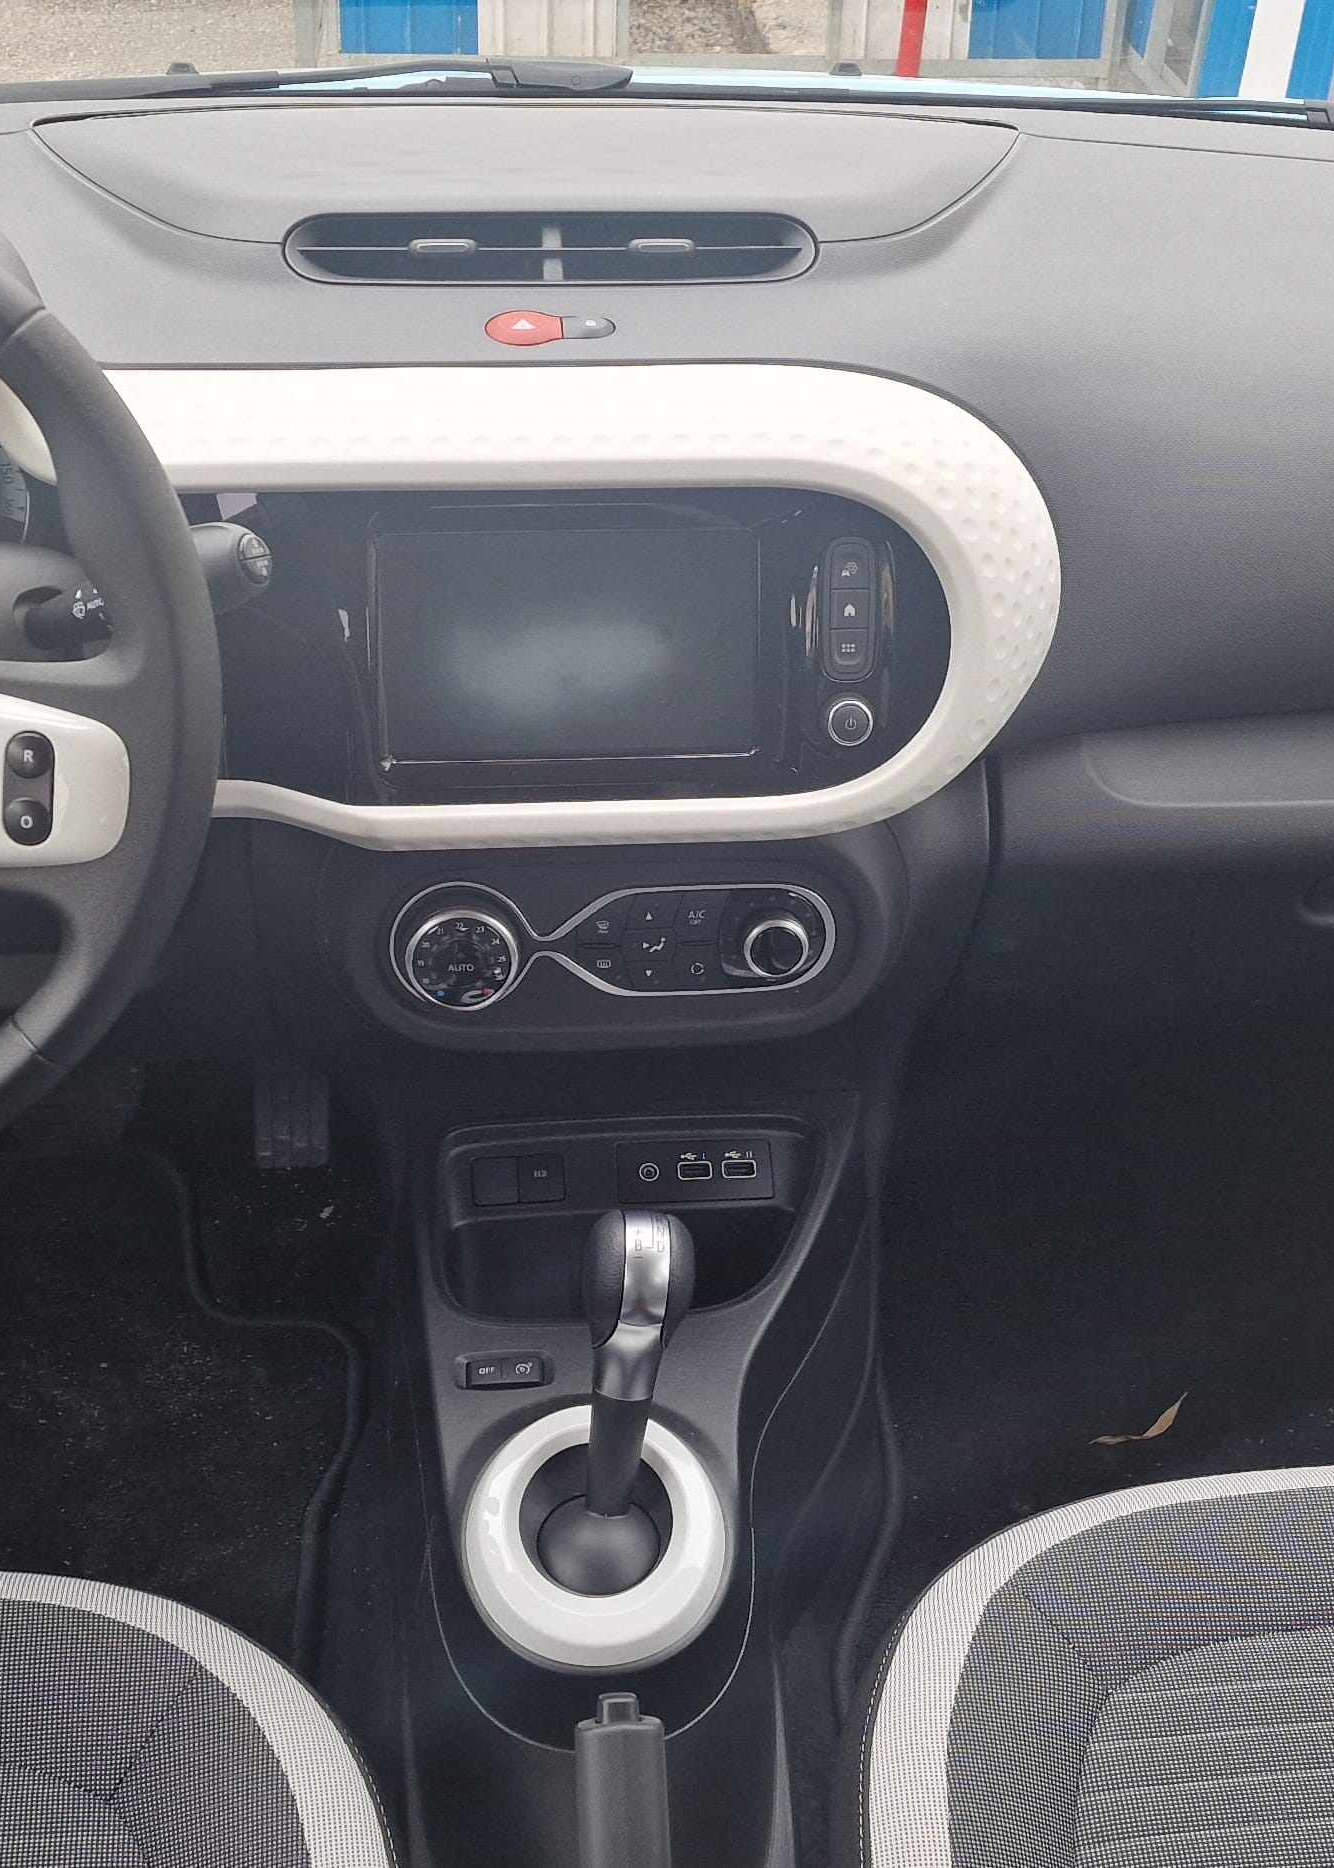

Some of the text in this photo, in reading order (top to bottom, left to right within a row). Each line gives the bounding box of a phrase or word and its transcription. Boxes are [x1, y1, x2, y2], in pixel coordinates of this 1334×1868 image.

[23, 749, 35, 764] R
[687, 910, 706, 920] A/C
[447, 963, 475, 973] AUTO
[634, 1238, 643, 1252] B
[656, 1240, 666, 1254] D
